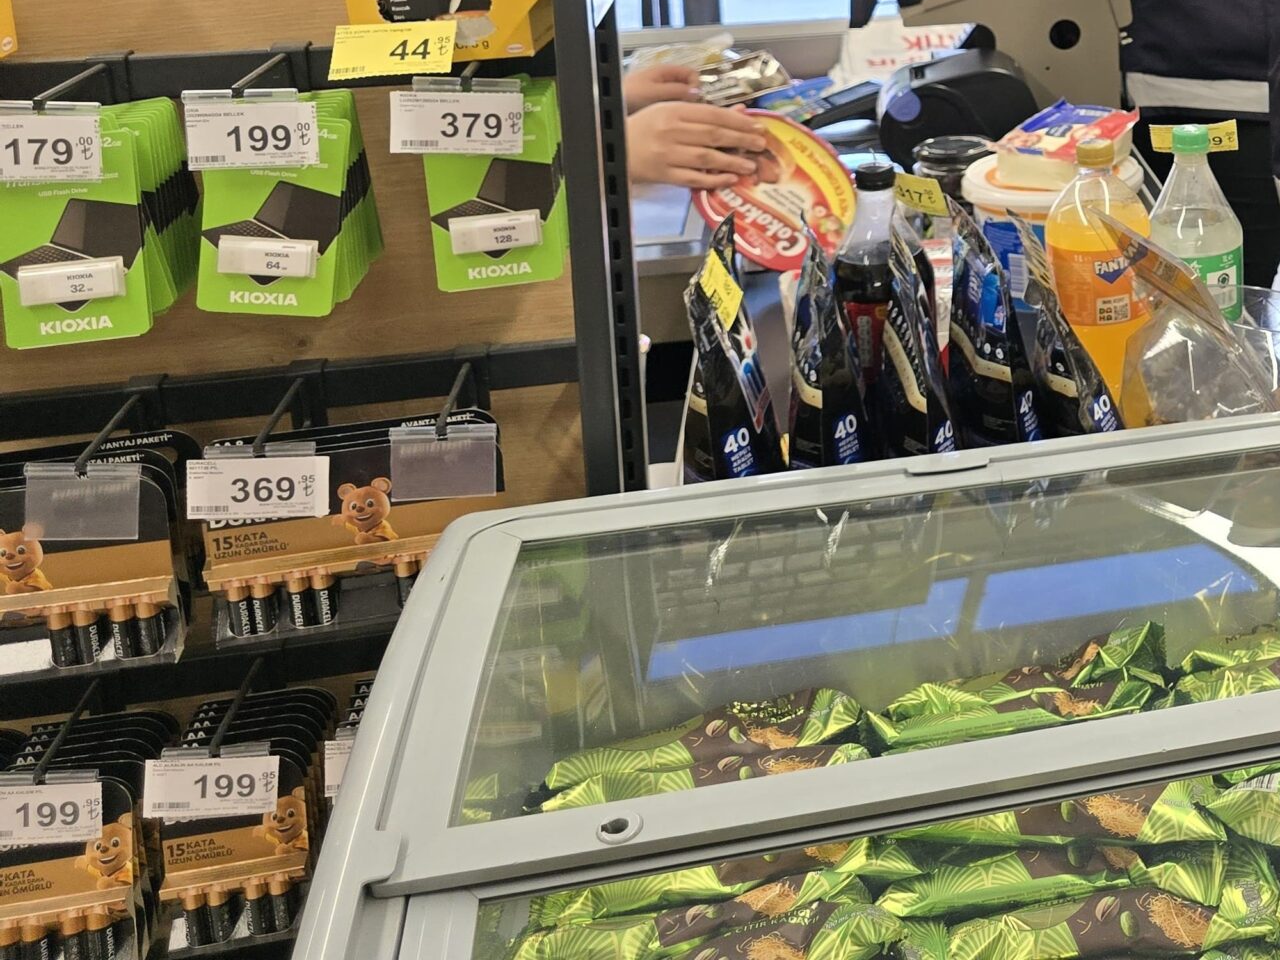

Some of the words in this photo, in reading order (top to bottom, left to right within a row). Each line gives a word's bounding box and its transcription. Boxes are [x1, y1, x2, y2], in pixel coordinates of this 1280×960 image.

[389, 38, 431, 61] 44
[440, 112, 502, 138] 379
[227, 124, 292, 152] 199
[5, 138, 73, 165] 179
[494, 234, 512, 244] 128
[266, 261, 281, 270] 64
[467, 261, 532, 280] KIOXIA
[67, 273, 93, 281] KIOXIA
[70, 283, 85, 293] 32
[229, 290, 298, 306] KIOXIA
[40, 315, 113, 335] KIOXIA
[1020, 390, 1033, 414] 40
[1093, 394, 1111, 421] 40
[834, 414, 857, 439] 40
[934, 420, 954, 445] 40
[723, 427, 750, 454] 40
[231, 476, 295, 503] 369
[213, 536, 233, 552] 15
[234, 531, 268, 543] KATA
[214, 549, 242, 560] UZUN
[187, 730, 206, 740] AA
[16, 756, 36, 765] AA
[194, 773, 256, 799] 199
[16, 801, 80, 827] 199
[167, 843, 186, 858] 15
[186, 838, 216, 850] KATA
[168, 856, 193, 865] UZUN
[5, 869, 35, 881] KATA
